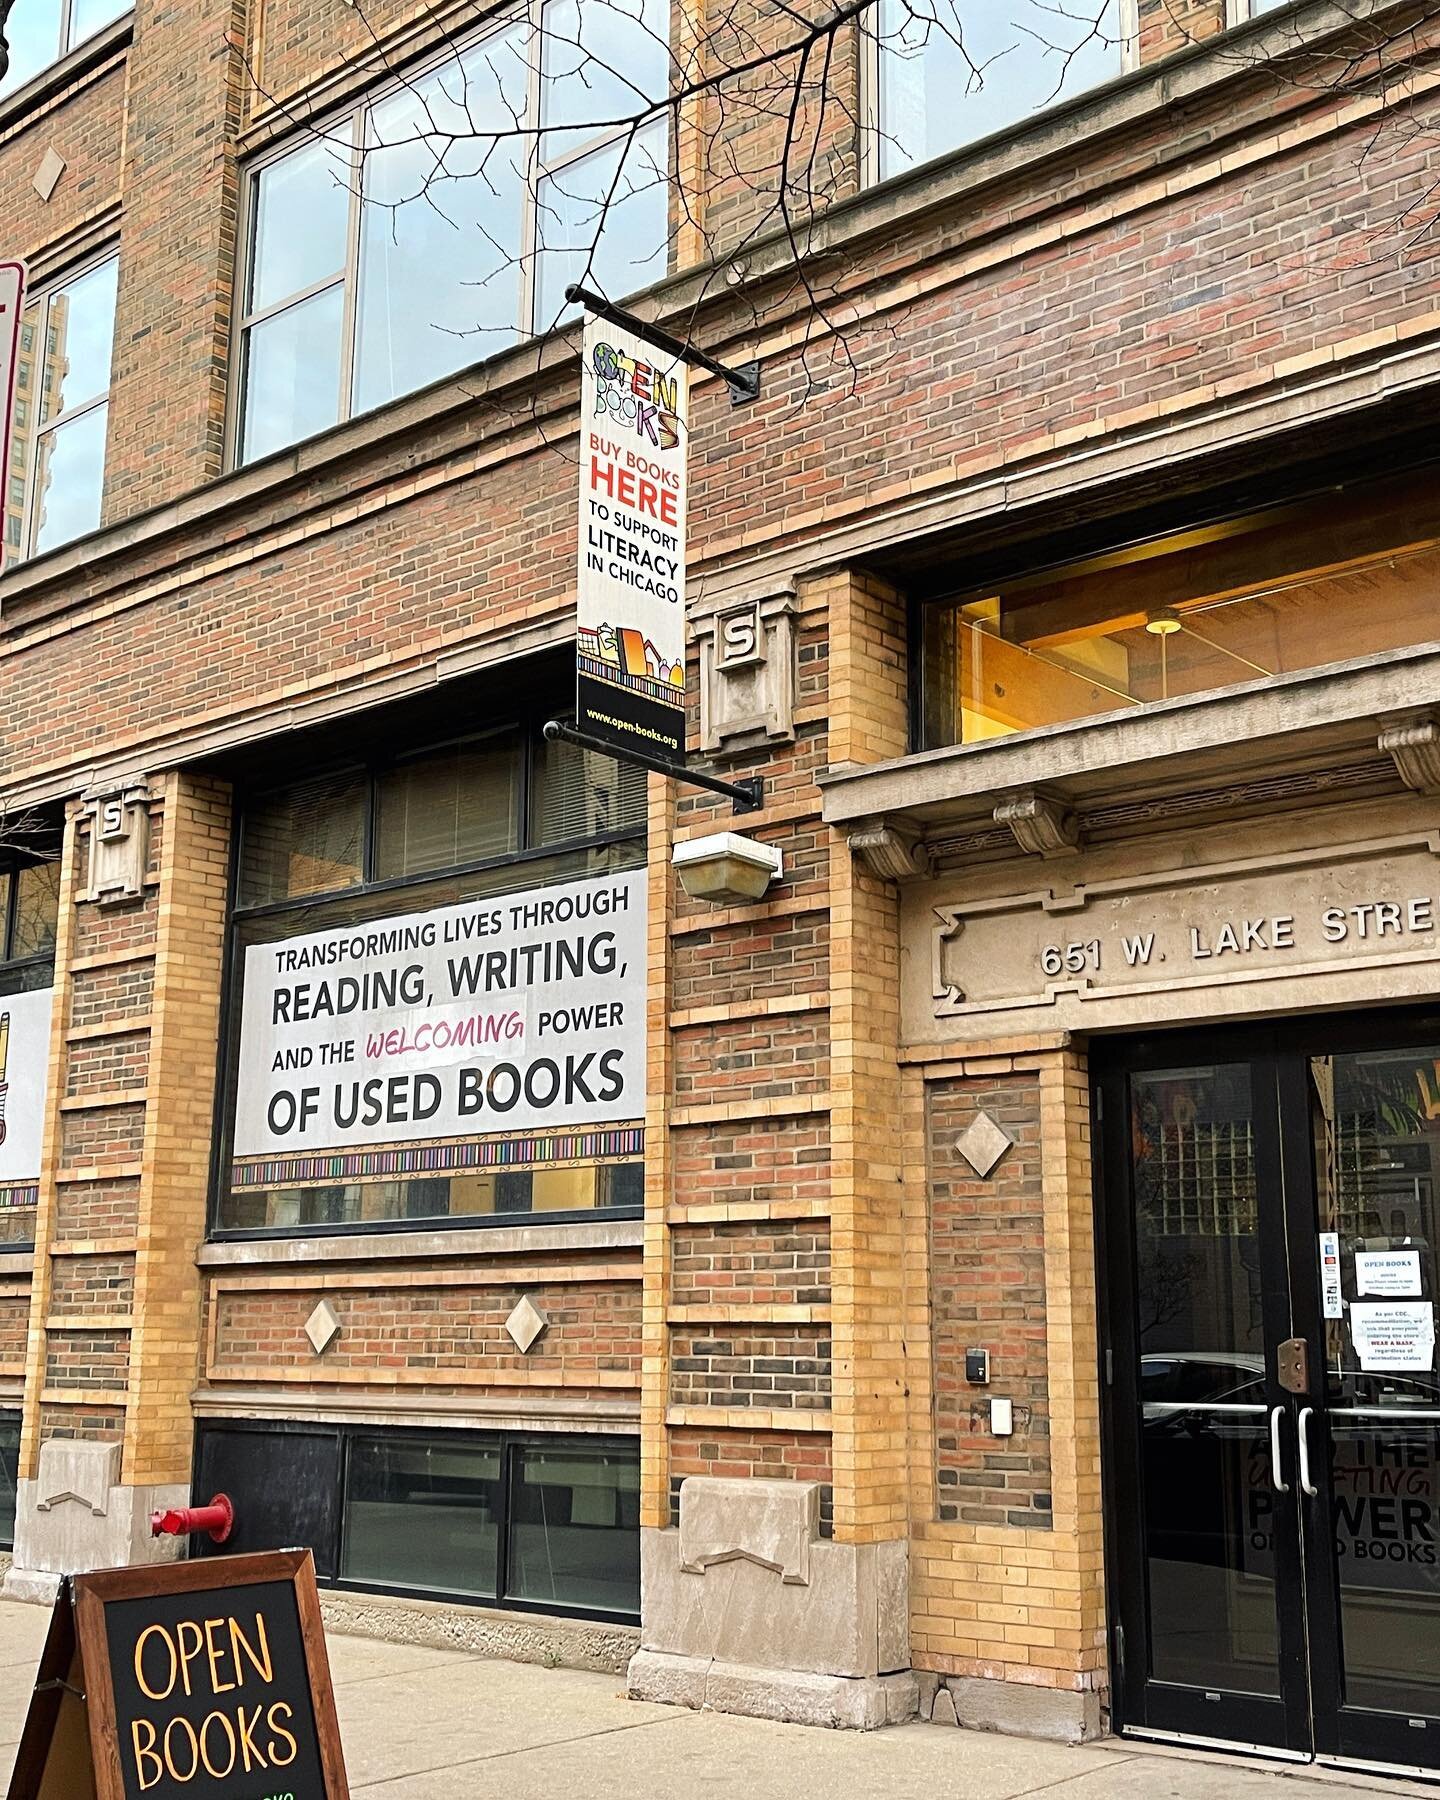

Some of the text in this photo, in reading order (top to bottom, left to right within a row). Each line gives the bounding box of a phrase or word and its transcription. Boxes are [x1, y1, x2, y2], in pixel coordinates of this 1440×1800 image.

[589, 432, 680, 490] BUY BOOKS
[590, 455, 678, 528] HERE
[588, 499, 679, 552] TO SUPPORT
[588, 524, 679, 581] LITERACY
[587, 551, 679, 604] IN CHICAGO
[586, 708, 679, 750] www.open-books.org
[275, 886, 629, 973] TRANSFORMING LIVES THROUGH
[1040, 896, 1440, 976] 651 W. LAKE STRE
[271, 931, 629, 1025] READING, WRITING,
[271, 1002, 624, 1072] AND THE WELCOMING POWER
[267, 1048, 624, 1136] OF USED BOOKS
[1353, 1539, 1437, 1564] BOOKS
[133, 1612, 273, 1701] OPEN
[131, 1701, 298, 1791] BOOKS
